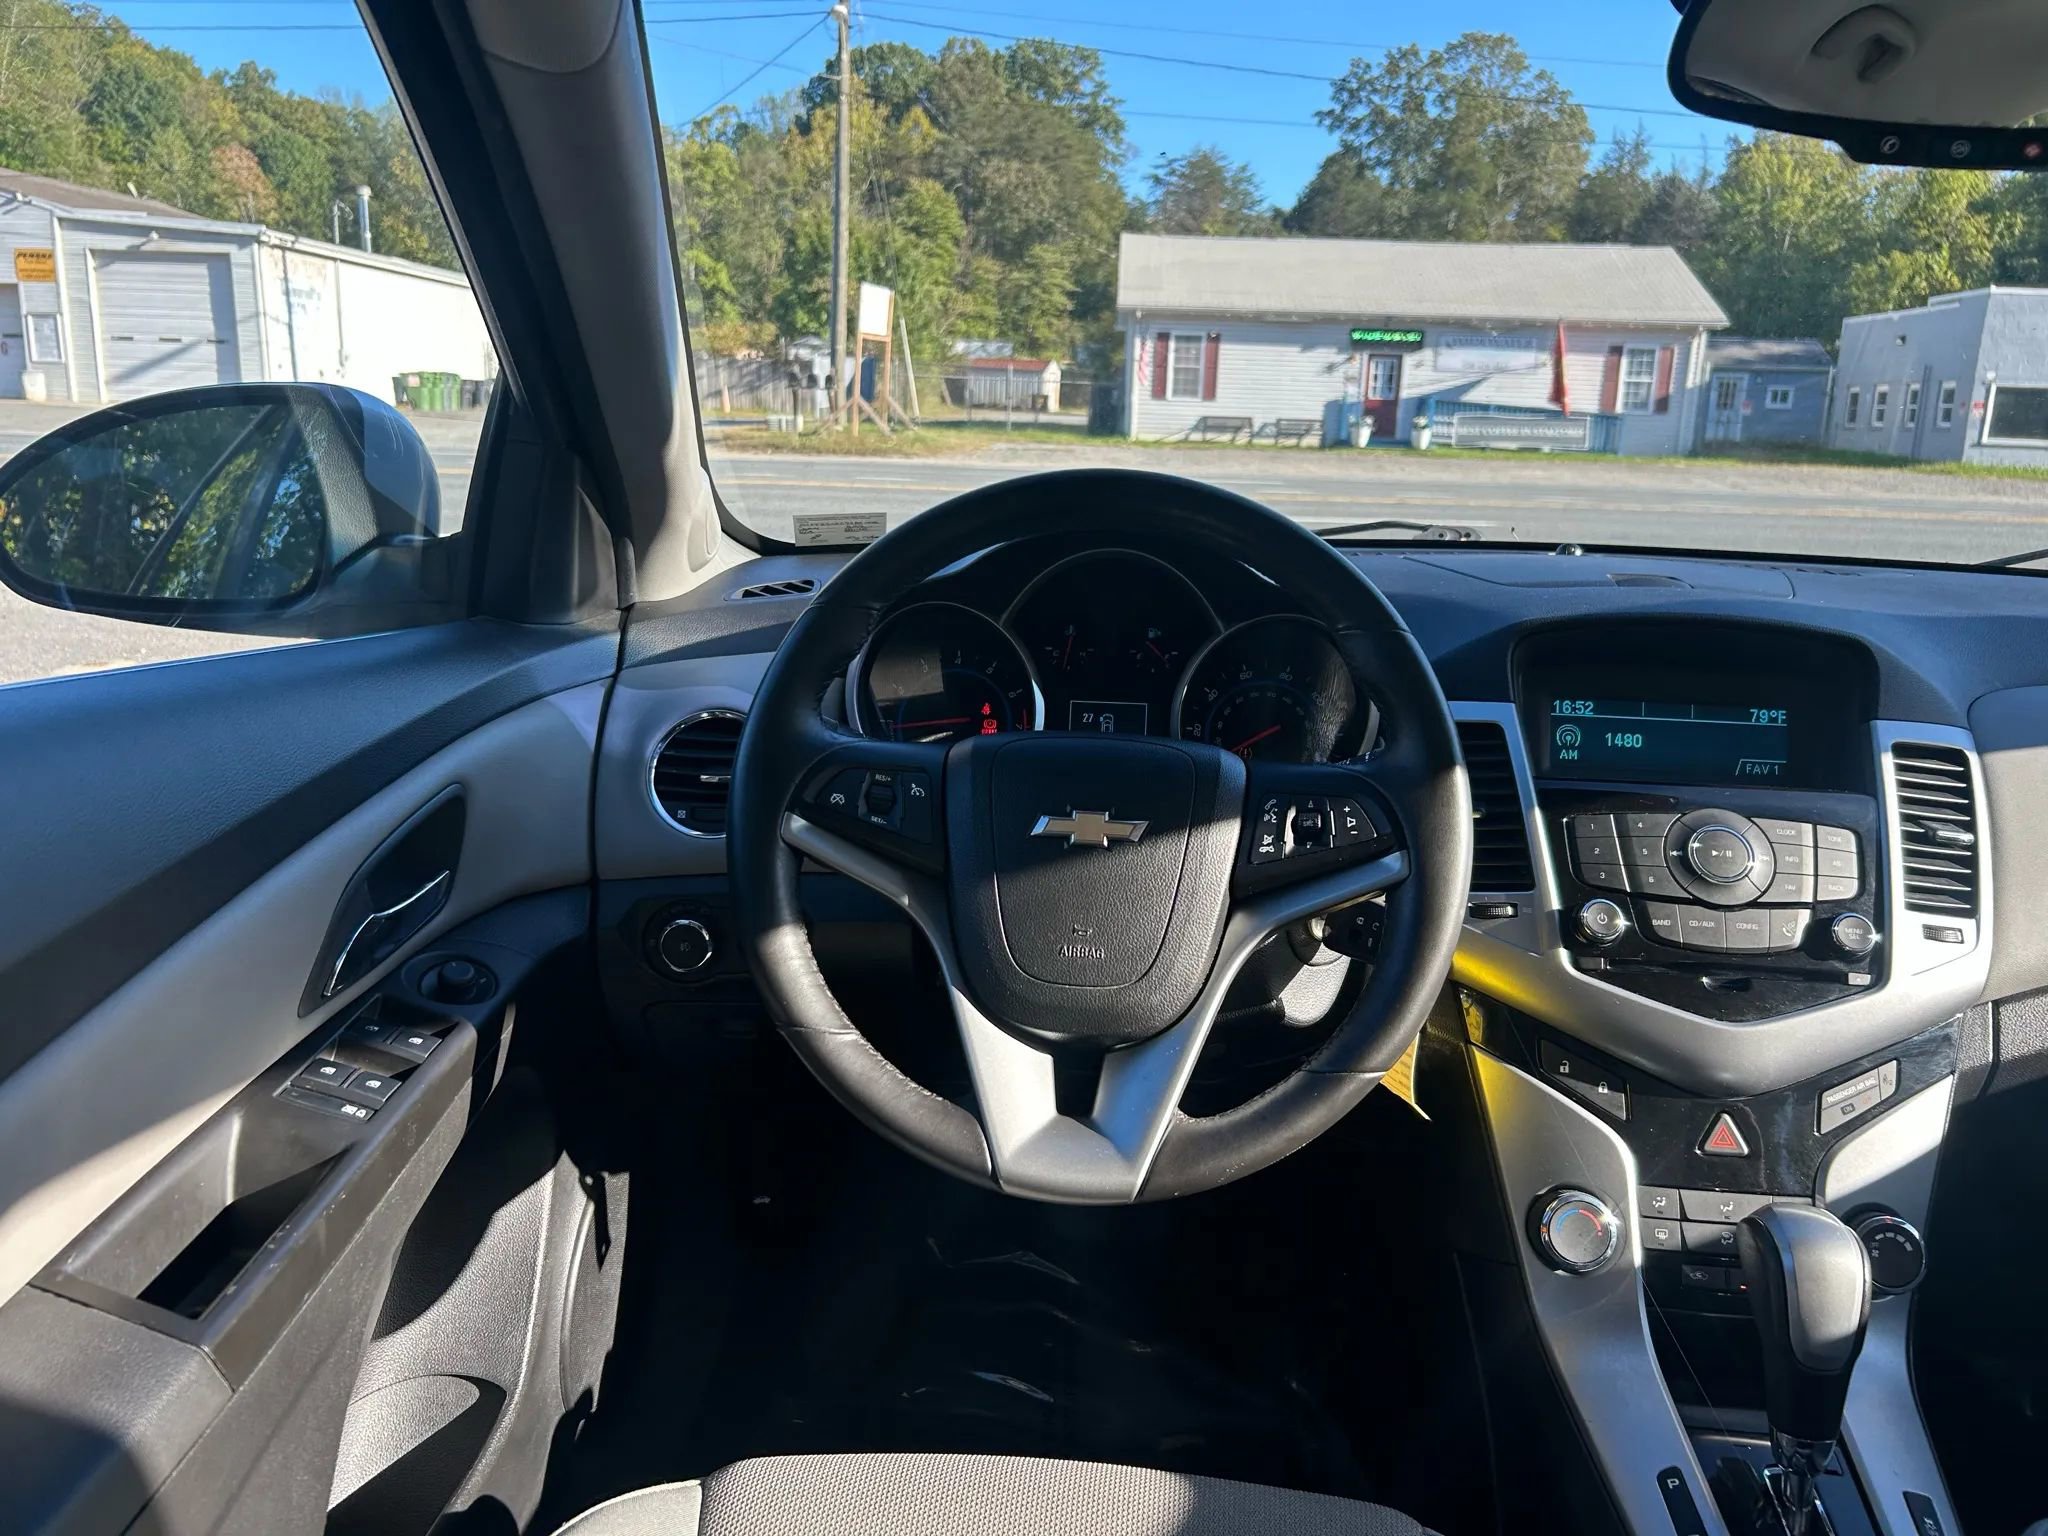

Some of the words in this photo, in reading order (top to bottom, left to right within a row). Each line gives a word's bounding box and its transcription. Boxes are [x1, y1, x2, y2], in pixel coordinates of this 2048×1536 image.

[1553, 700, 1594, 715] 16:52
[1082, 713, 1094, 723] 27
[1750, 709, 1787, 724] 79°F
[1605, 733, 1642, 748] 1480
[1559, 750, 1578, 760] AM
[1746, 763, 1769, 776] FAV
[1774, 764, 1780, 776] 1
[1689, 920, 1715, 928] CD/AUX
[1736, 922, 1759, 930] CONFIG
[1059, 945, 1105, 959] AIRBAG
[1826, 1086, 1857, 1103] PASSENGER
[1864, 1077, 1876, 1087] BAG
[1667, 1478, 1680, 1489] P
